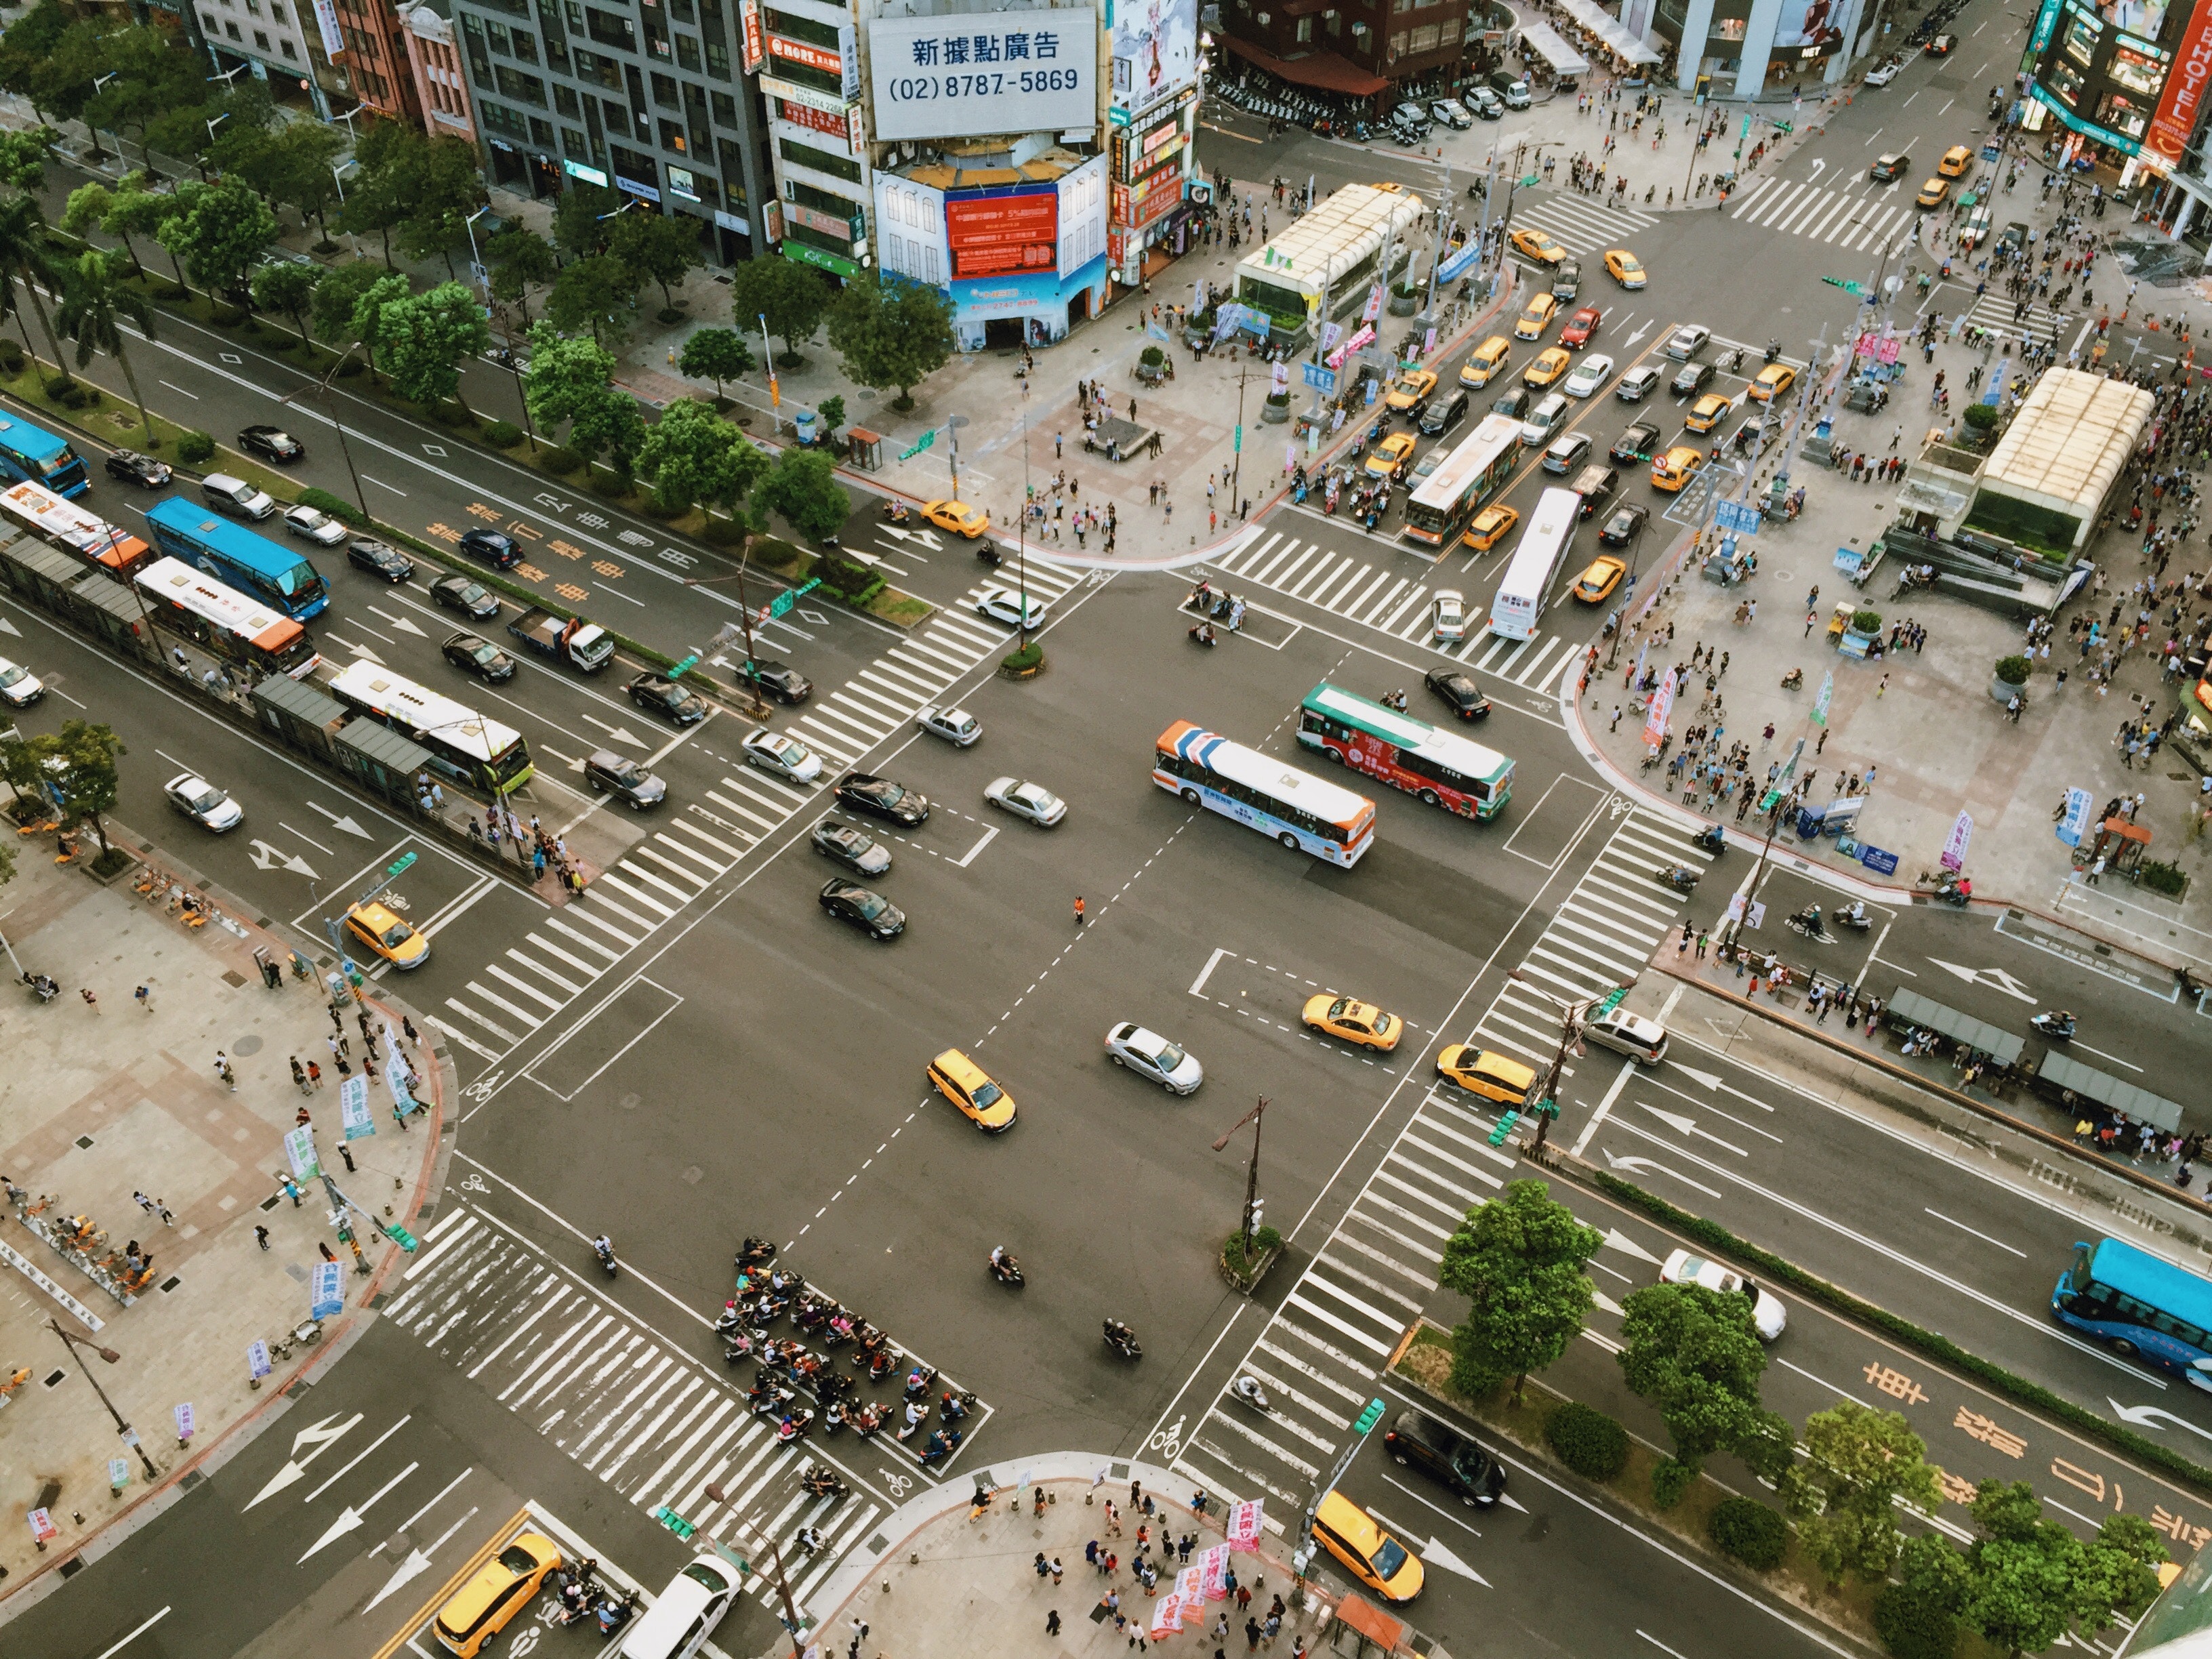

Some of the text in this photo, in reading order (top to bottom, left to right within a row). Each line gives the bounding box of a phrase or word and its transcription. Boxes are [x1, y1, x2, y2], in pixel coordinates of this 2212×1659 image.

[912, 31, 1059, 66] 新據點廣告
[1801, 46, 1821, 58] NET
[2172, 44, 2212, 122] HOTEL
[426, 523, 590, 602] 禁機車
[466, 502, 627, 579] 禁行機車
